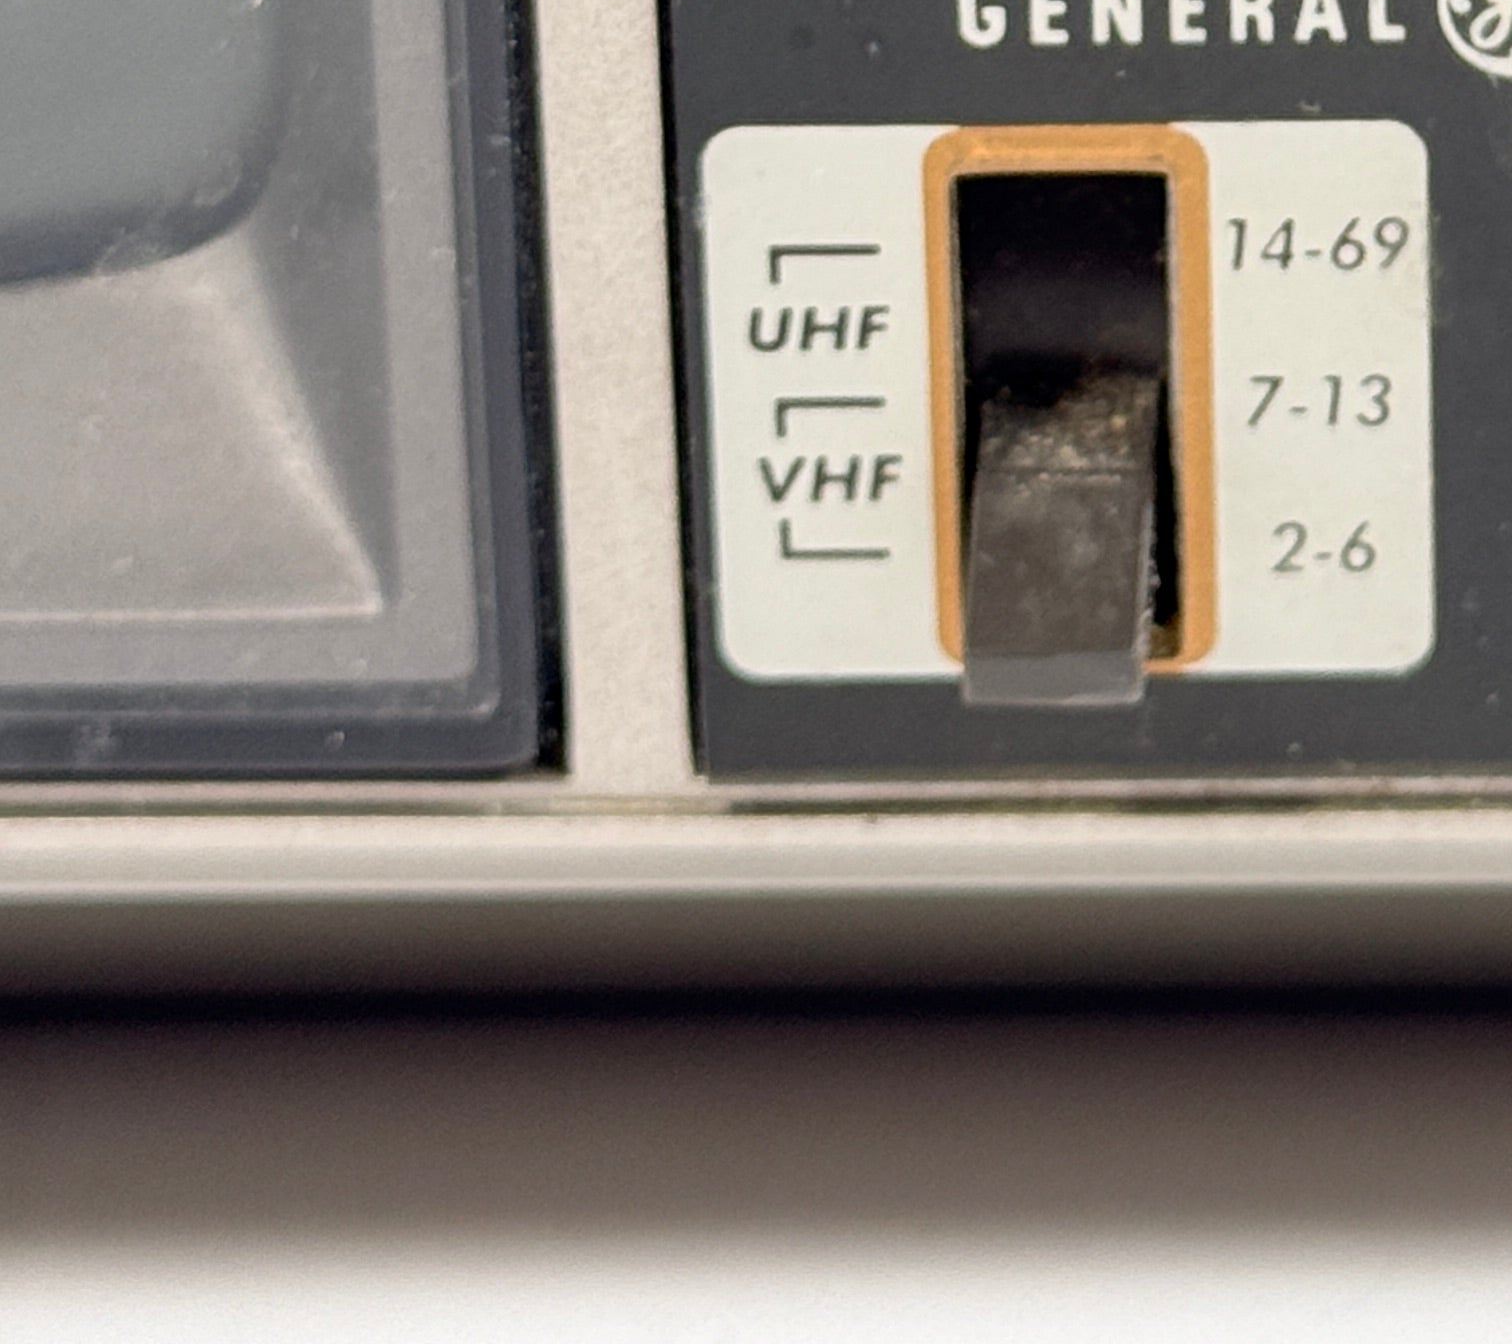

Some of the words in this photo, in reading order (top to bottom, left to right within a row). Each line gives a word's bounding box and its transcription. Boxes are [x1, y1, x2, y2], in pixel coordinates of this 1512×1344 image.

[1228, 216, 1410, 272] 14-69
[747, 305, 890, 354] UHF
[1247, 373, 1392, 427] 7-13
[758, 454, 903, 504] VHF
[1273, 521, 1376, 574] 2-6
